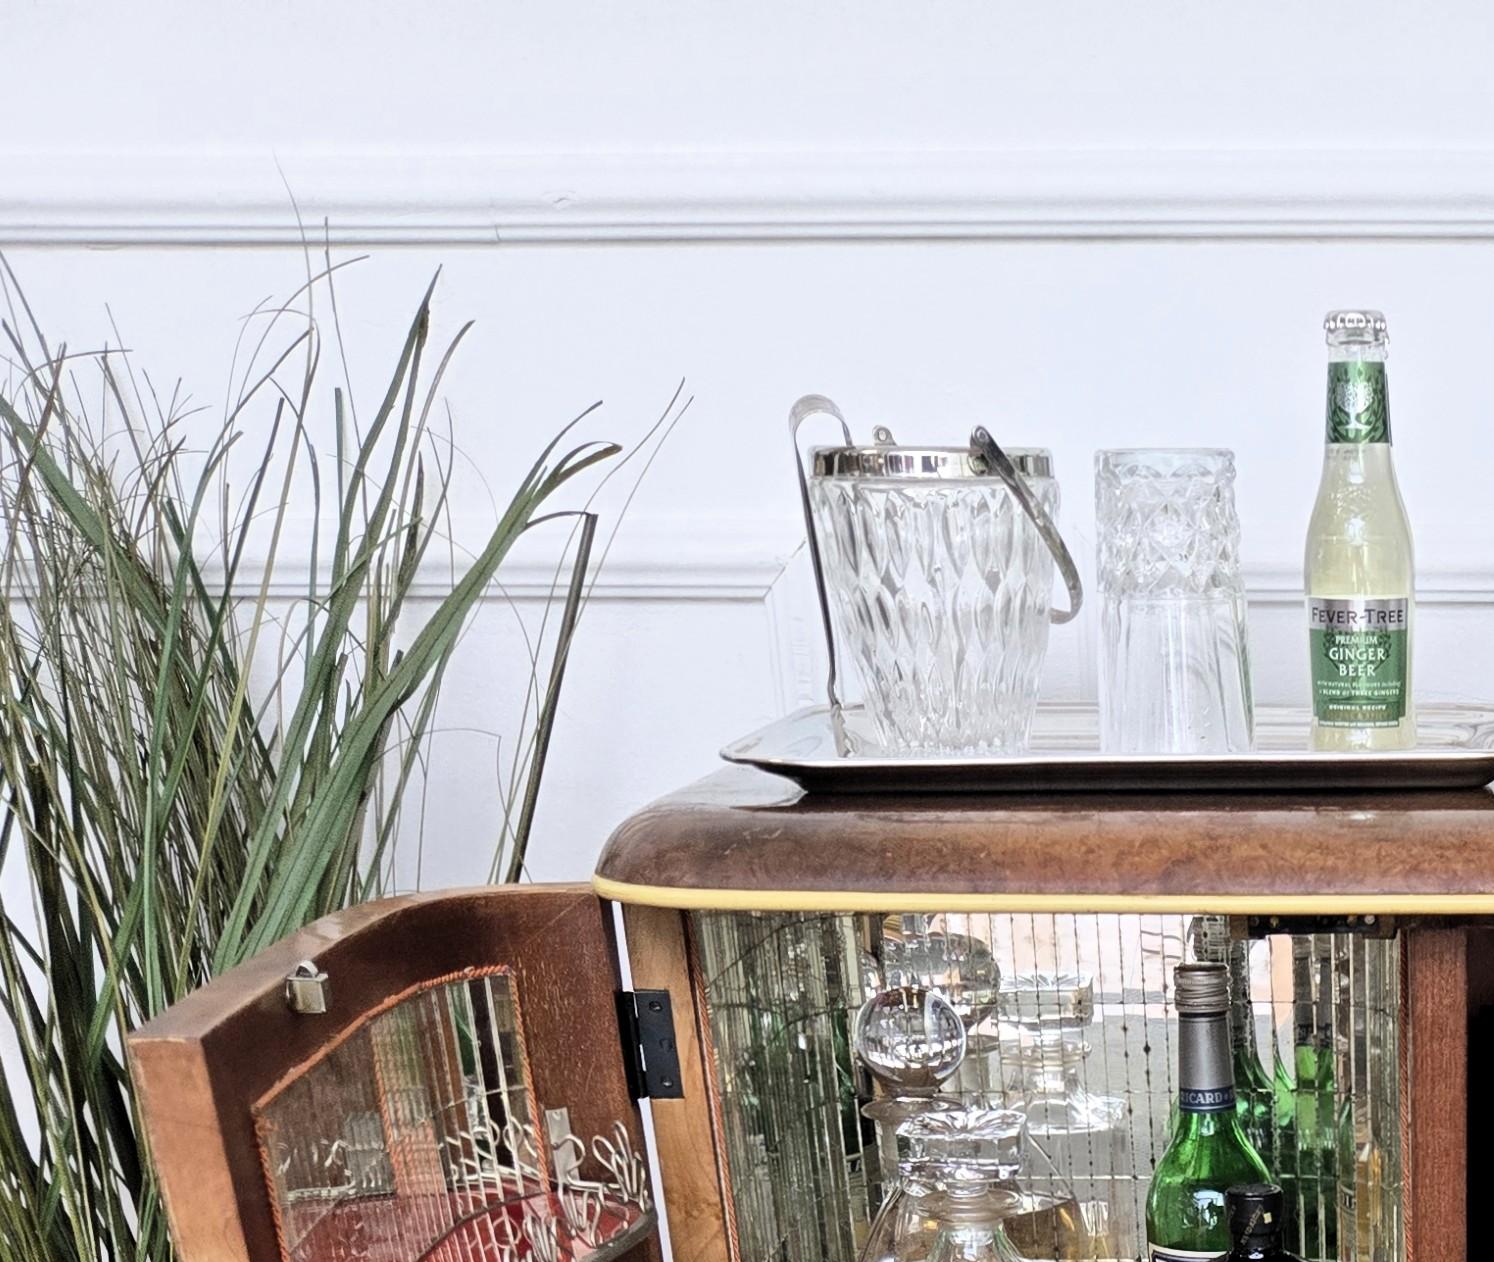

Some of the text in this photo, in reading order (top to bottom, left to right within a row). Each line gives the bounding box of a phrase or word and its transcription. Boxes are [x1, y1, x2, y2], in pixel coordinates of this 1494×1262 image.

[1312, 606, 1404, 624] FEVER-TREE
[1328, 646, 1386, 661] GINGER
[1339, 663, 1376, 677] BEER
